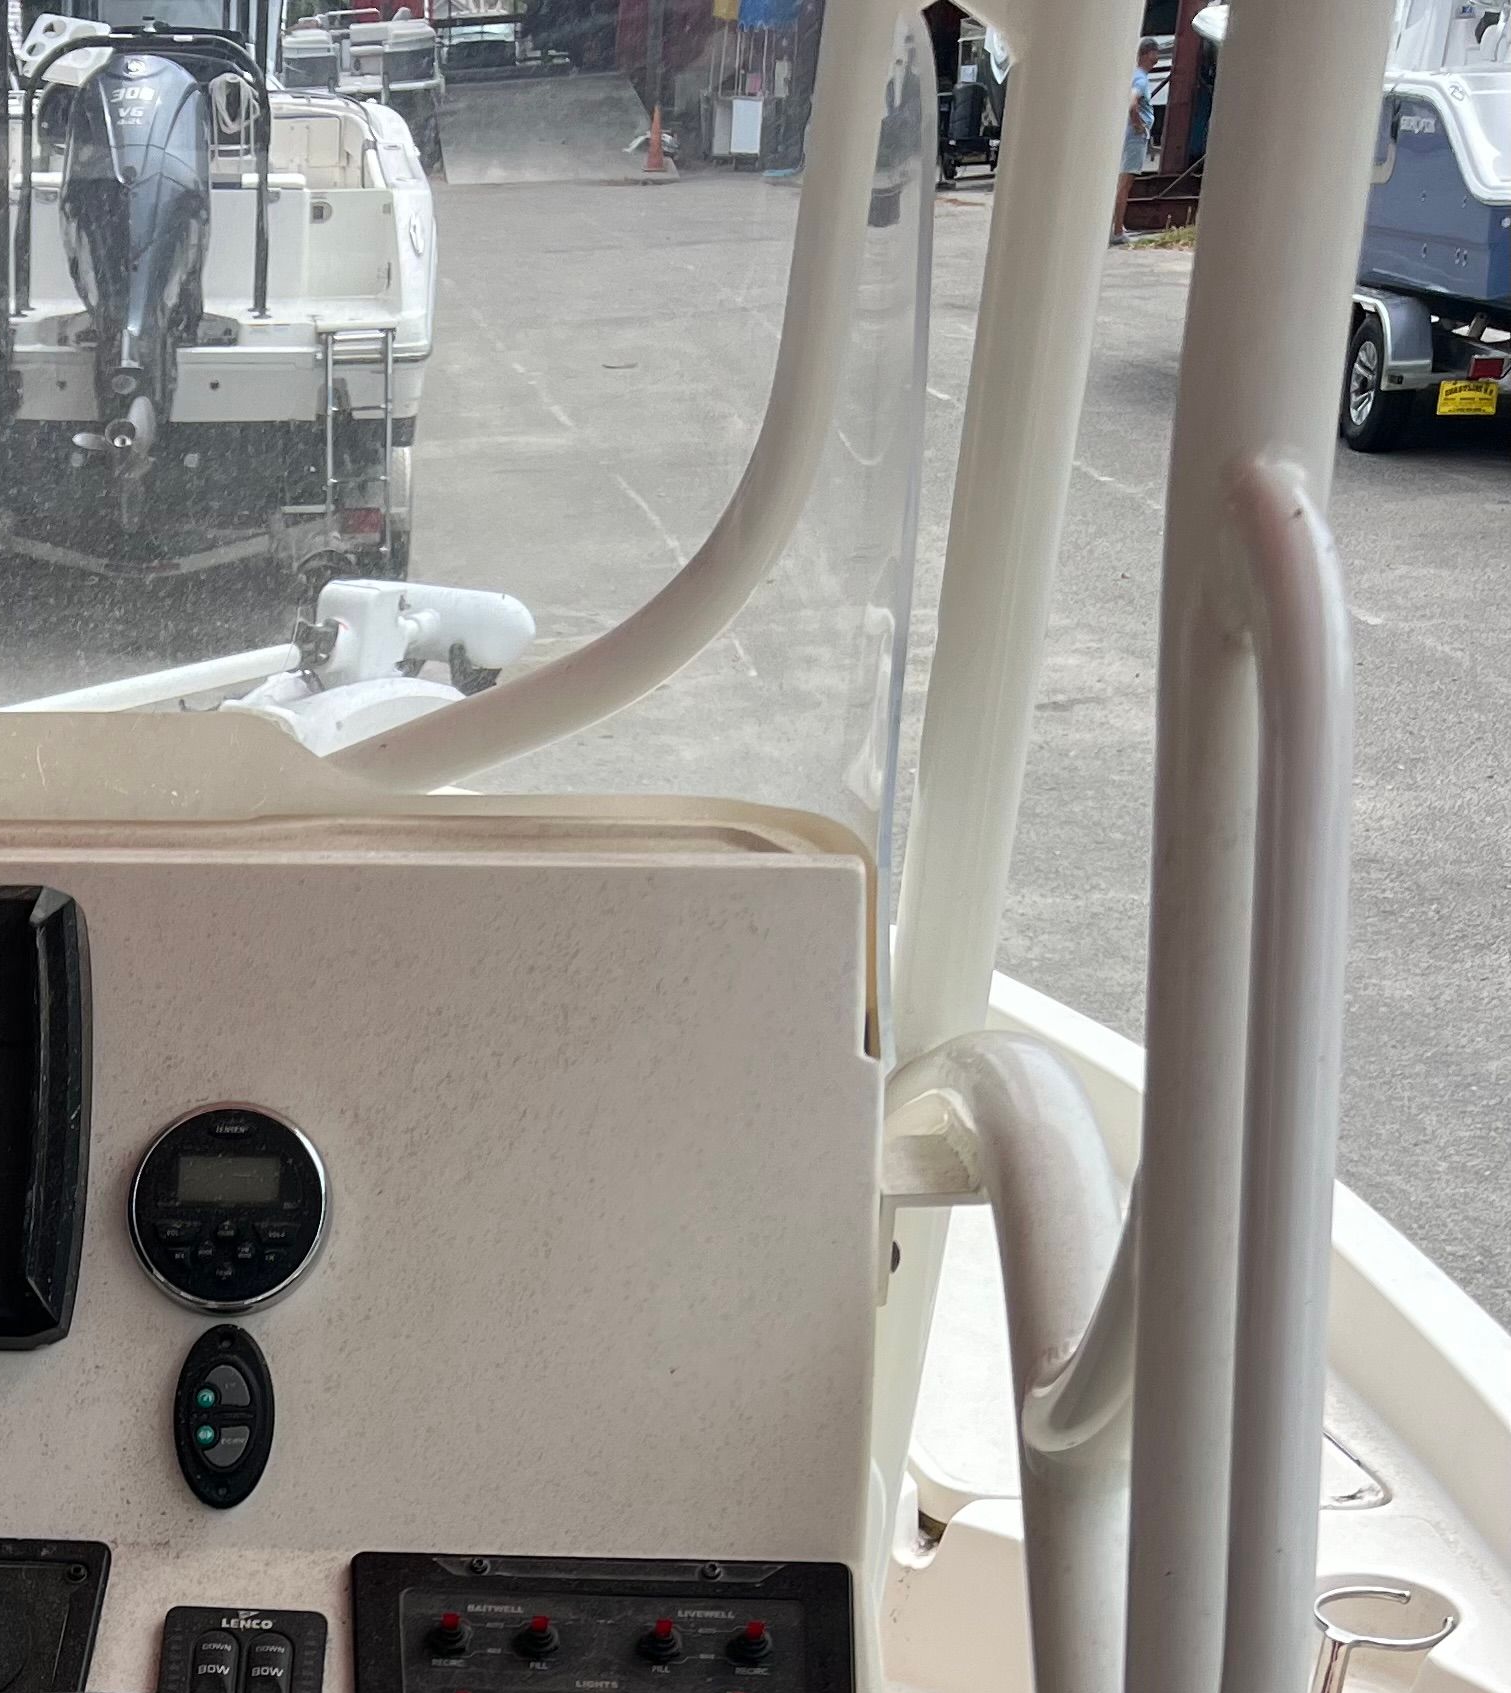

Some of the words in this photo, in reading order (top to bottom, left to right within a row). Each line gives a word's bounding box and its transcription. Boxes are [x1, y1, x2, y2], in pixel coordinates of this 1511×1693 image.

[677, 1610, 736, 1620] LIVEWELL
[221, 1617, 274, 1630] LENCO
[197, 1664, 230, 1675] BOW
[251, 1666, 284, 1677] BOW
[575, 1680, 619, 1689] LIGHTS
